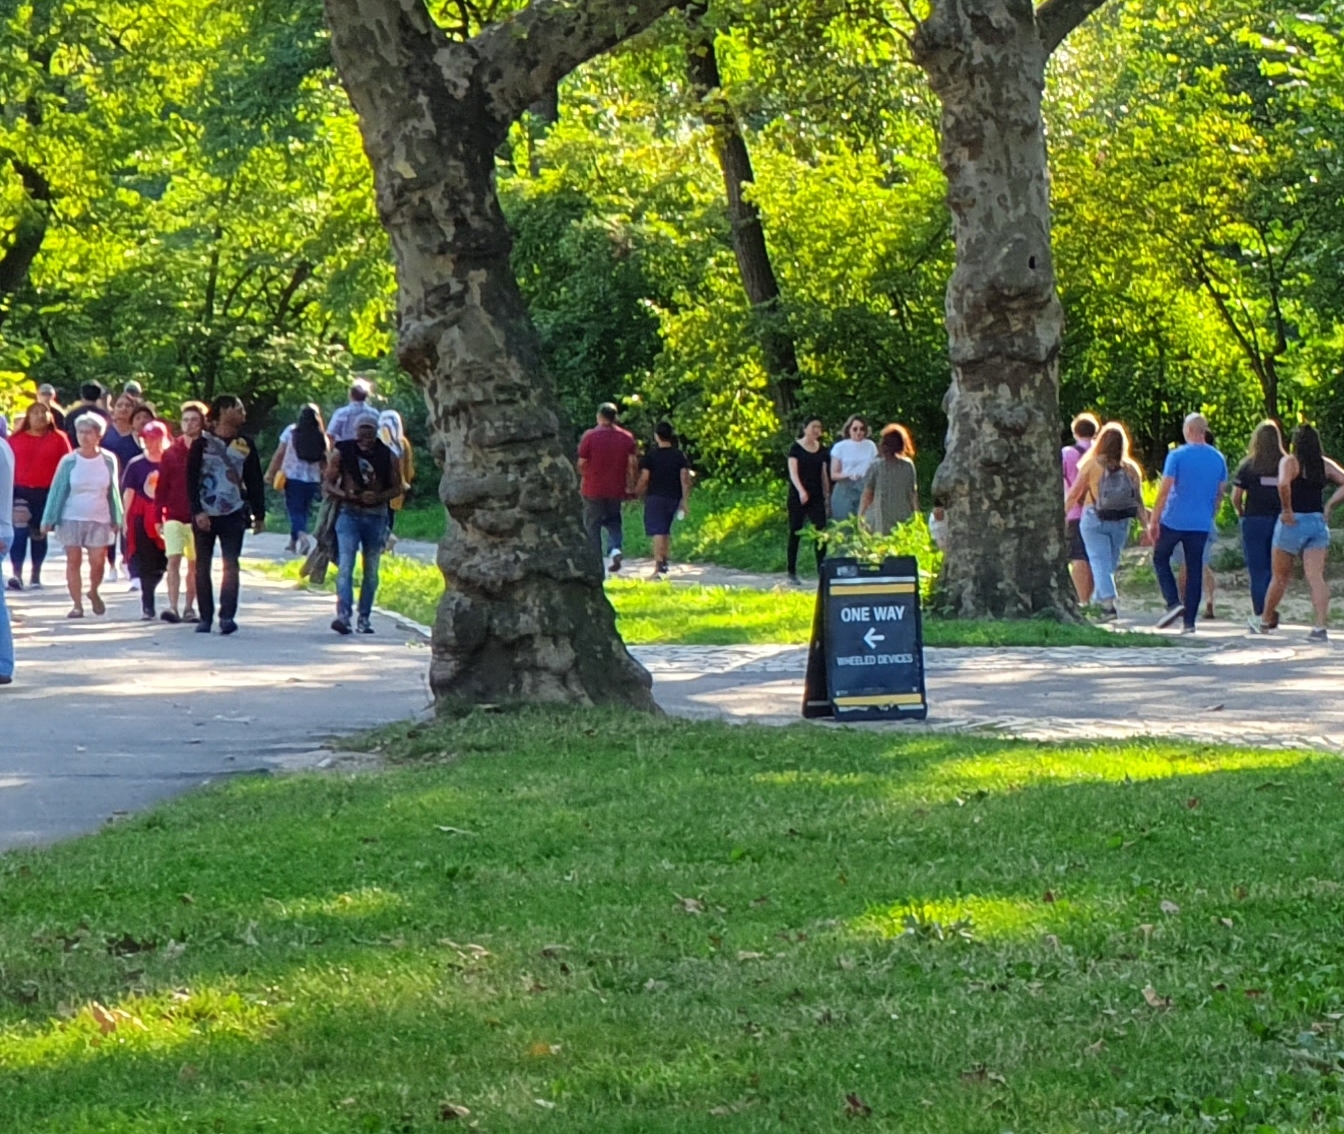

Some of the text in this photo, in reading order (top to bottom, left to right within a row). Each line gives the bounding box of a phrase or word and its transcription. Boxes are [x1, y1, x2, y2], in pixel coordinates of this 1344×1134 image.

[841, 606, 905, 622] ONE WAY
[837, 653, 913, 666] WHEELED DEVICES
